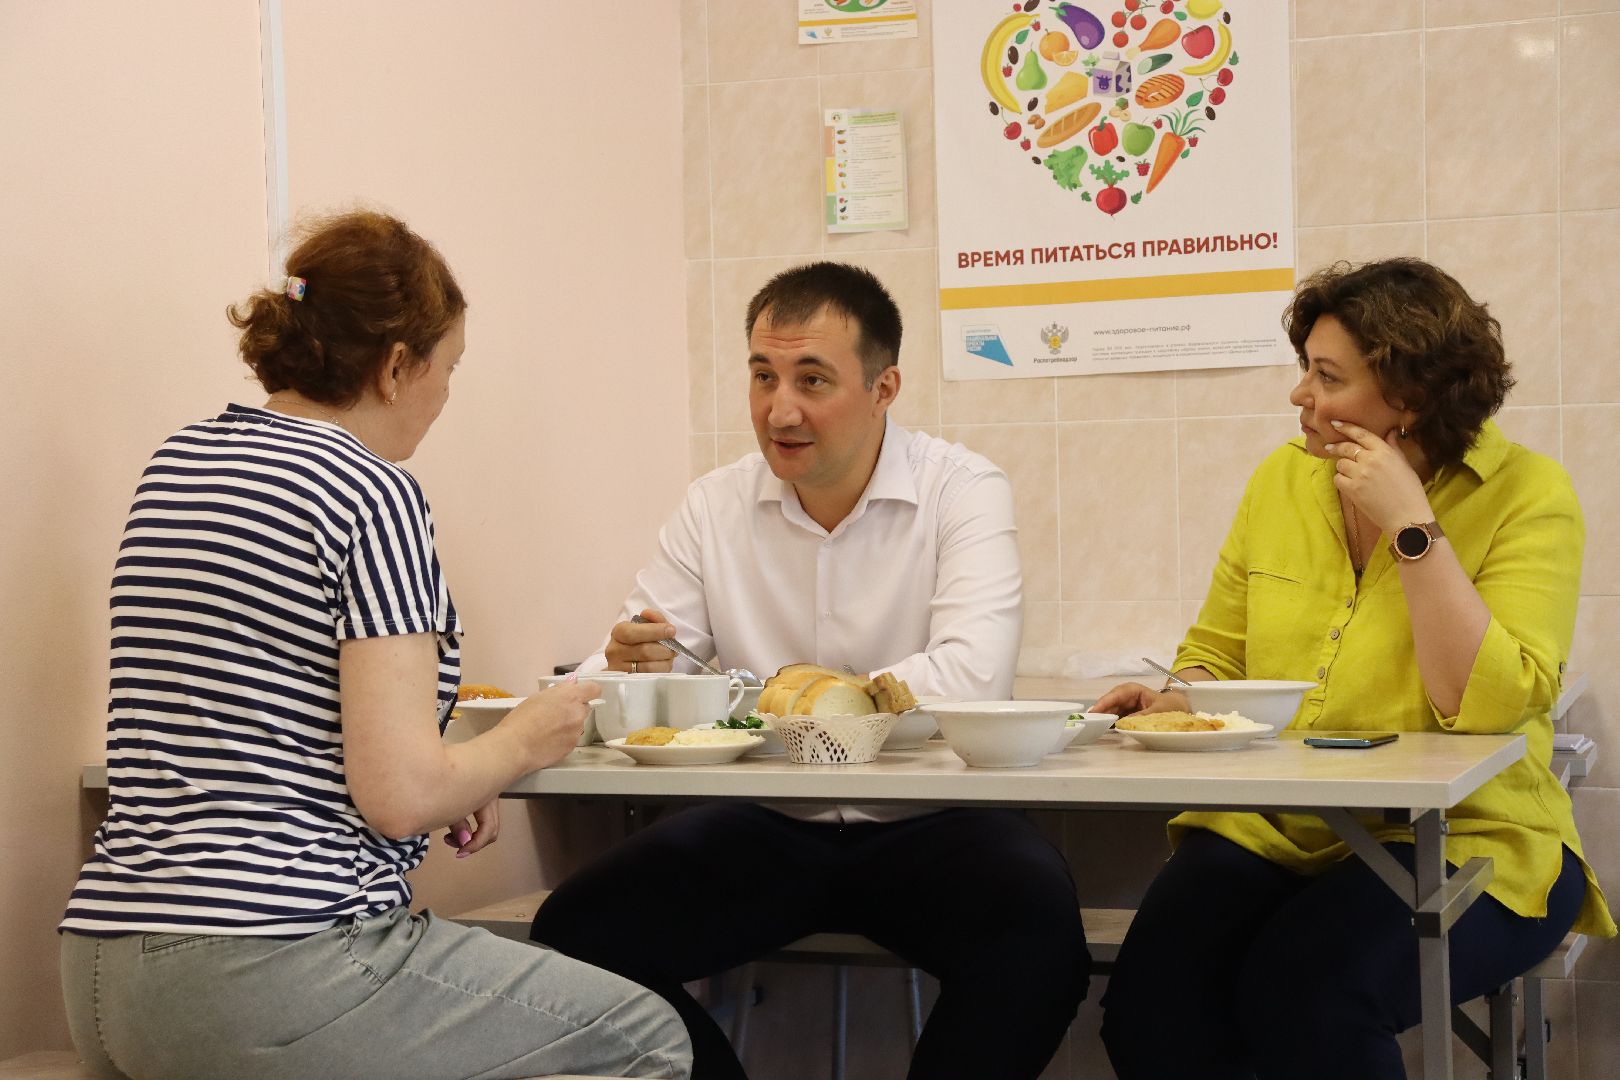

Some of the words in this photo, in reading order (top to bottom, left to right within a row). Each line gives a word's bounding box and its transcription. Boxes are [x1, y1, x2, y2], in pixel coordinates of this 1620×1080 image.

[958, 249, 1024, 269] ВРЕМЯ
[1031, 242, 1135, 264] ПИТАТЬСЯ
[1143, 232, 1278, 257] ПРАВИЛЬНО!
